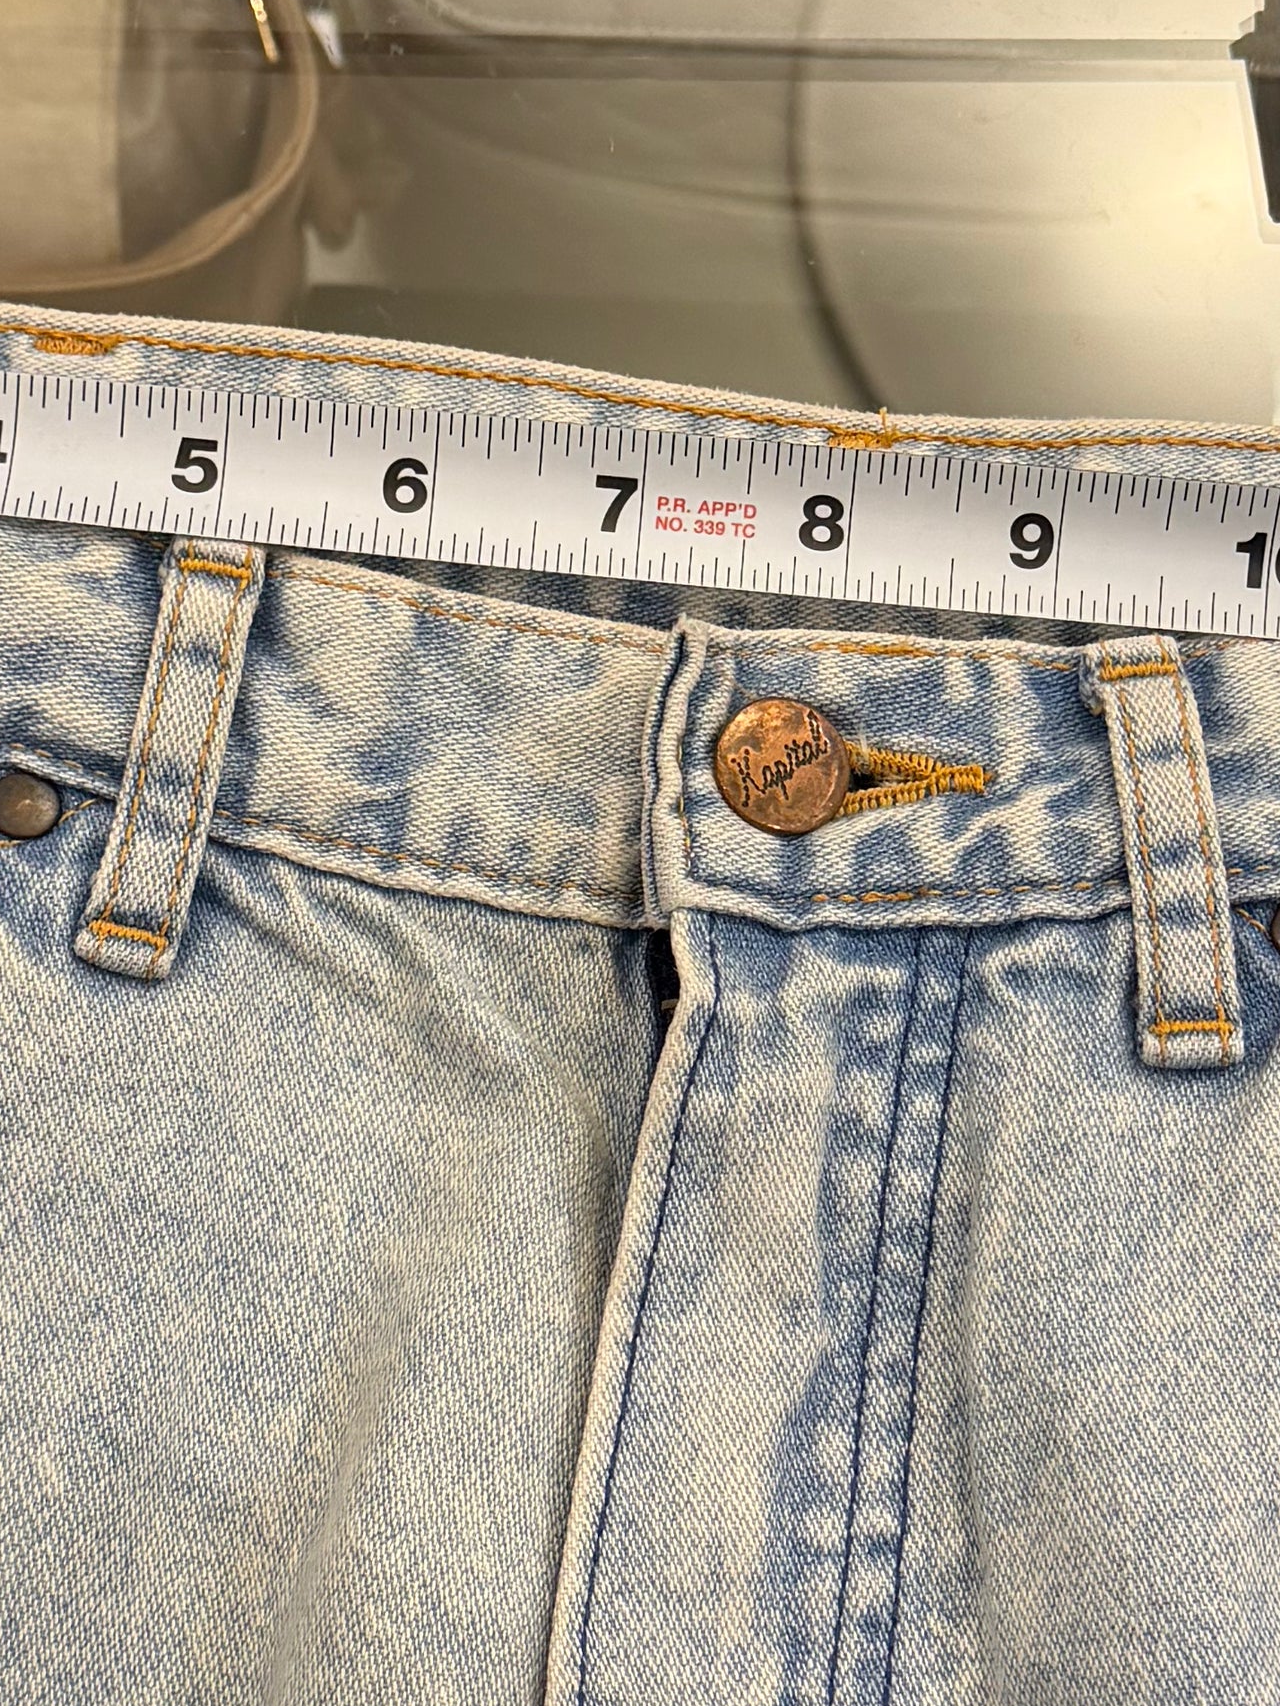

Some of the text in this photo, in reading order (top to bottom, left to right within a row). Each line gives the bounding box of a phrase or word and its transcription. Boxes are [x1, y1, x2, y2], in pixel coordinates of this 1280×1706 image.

[170, 437, 219, 493] 5
[382, 458, 429, 513] 6
[595, 474, 639, 533] 7
[655, 516, 756, 538] NO. 339 TC
[657, 496, 757, 519] P.R. APP'D
[798, 495, 845, 552] 8
[1009, 513, 1054, 570] 9
